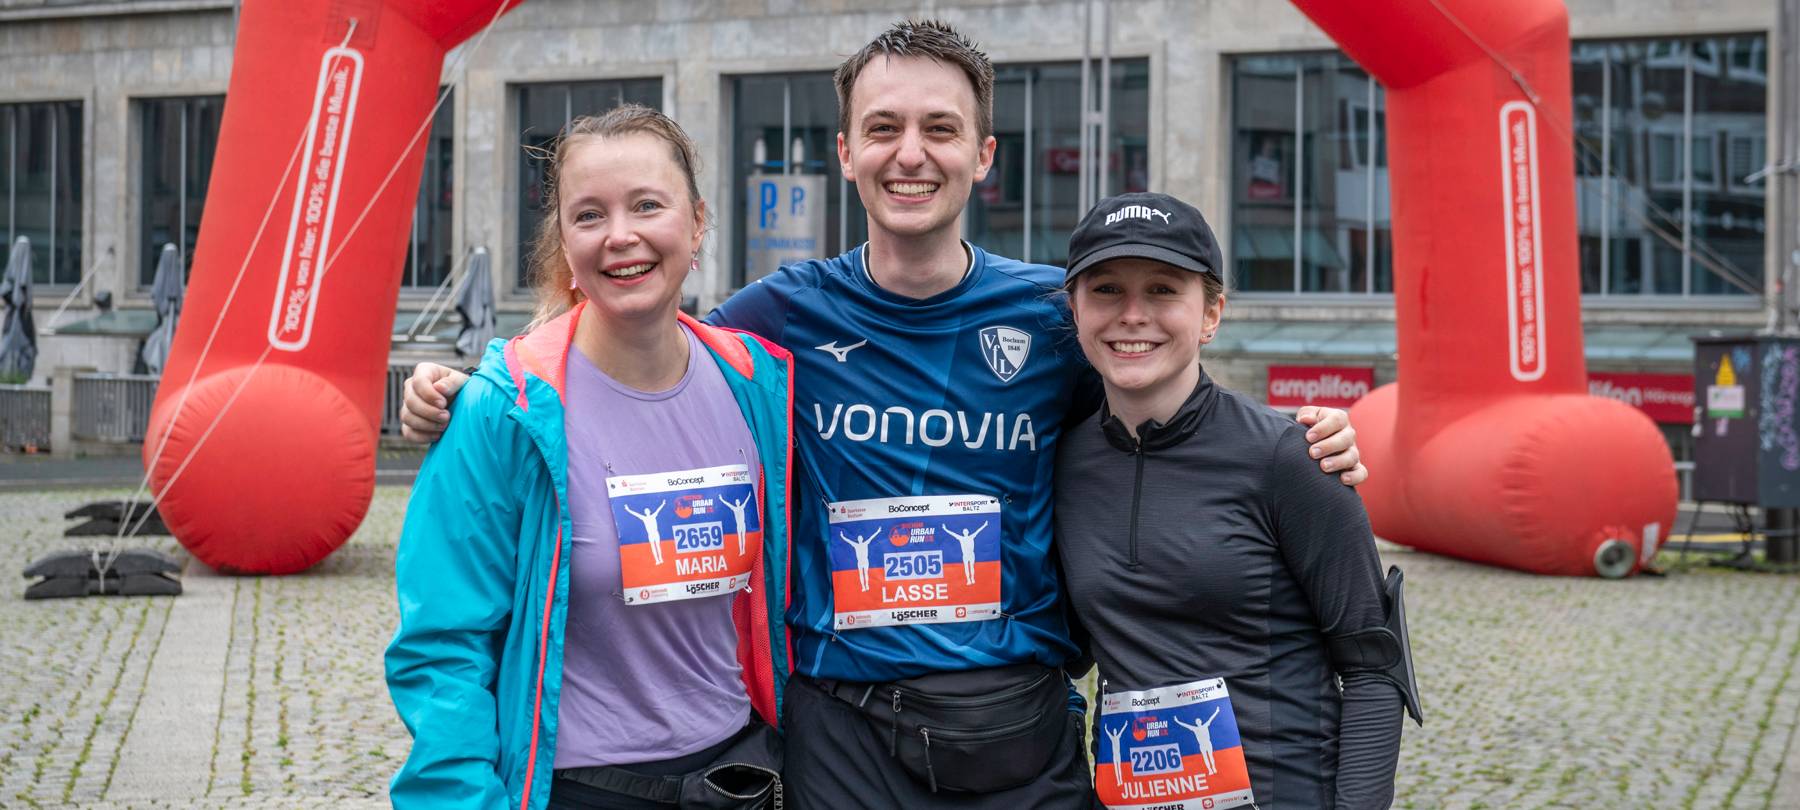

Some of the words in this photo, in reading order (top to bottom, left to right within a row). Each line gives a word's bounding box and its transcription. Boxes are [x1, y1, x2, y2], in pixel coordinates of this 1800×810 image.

[319, 114, 339, 156] beste
[316, 156, 331, 181] die
[305, 181, 327, 225] 100%
[1105, 205, 1152, 226] PUMA
[296, 259, 311, 286] von
[283, 287, 305, 333] 100%
[1002, 336, 1026, 344] Bochum
[1270, 374, 1369, 404] amplifon
[814, 403, 1036, 452] VONOVIA
[667, 475, 705, 487] BoConcept
[692, 499, 714, 508] URBAN
[888, 503, 930, 513] BoConcept
[675, 525, 723, 551] 2659
[910, 527, 935, 536] URBAN
[910, 535, 925, 544] RUN
[675, 555, 728, 577] MARIA
[885, 554, 942, 578] 2505
[686, 581, 720, 595] LÖSCHER
[882, 583, 949, 604] LASSE
[892, 609, 938, 621] LÖSCHER
[1182, 686, 1215, 698] INTERSPORT
[1146, 720, 1168, 730] URBAN
[1131, 748, 1181, 773] 2206
[1121, 773, 1209, 799] JULIENNE
